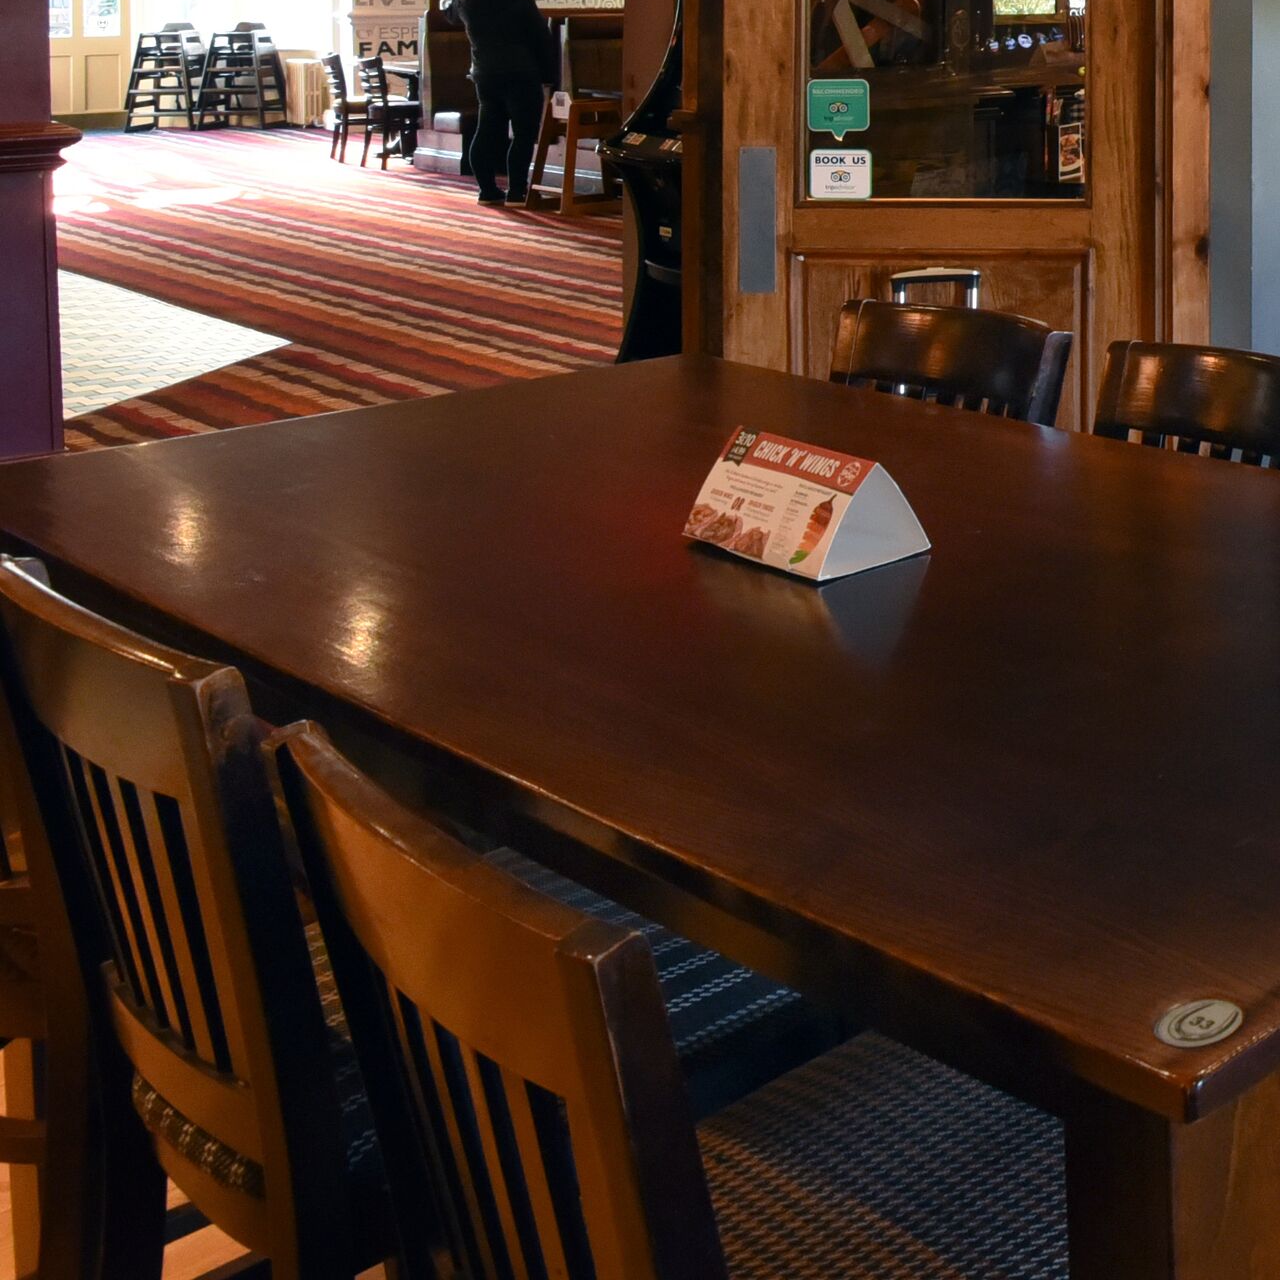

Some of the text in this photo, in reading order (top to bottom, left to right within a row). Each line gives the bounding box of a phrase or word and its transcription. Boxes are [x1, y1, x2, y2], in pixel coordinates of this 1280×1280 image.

[815, 156, 866, 165] BOOK US
[753, 439, 791, 464] CHICK
[799, 451, 841, 478] WINGS
